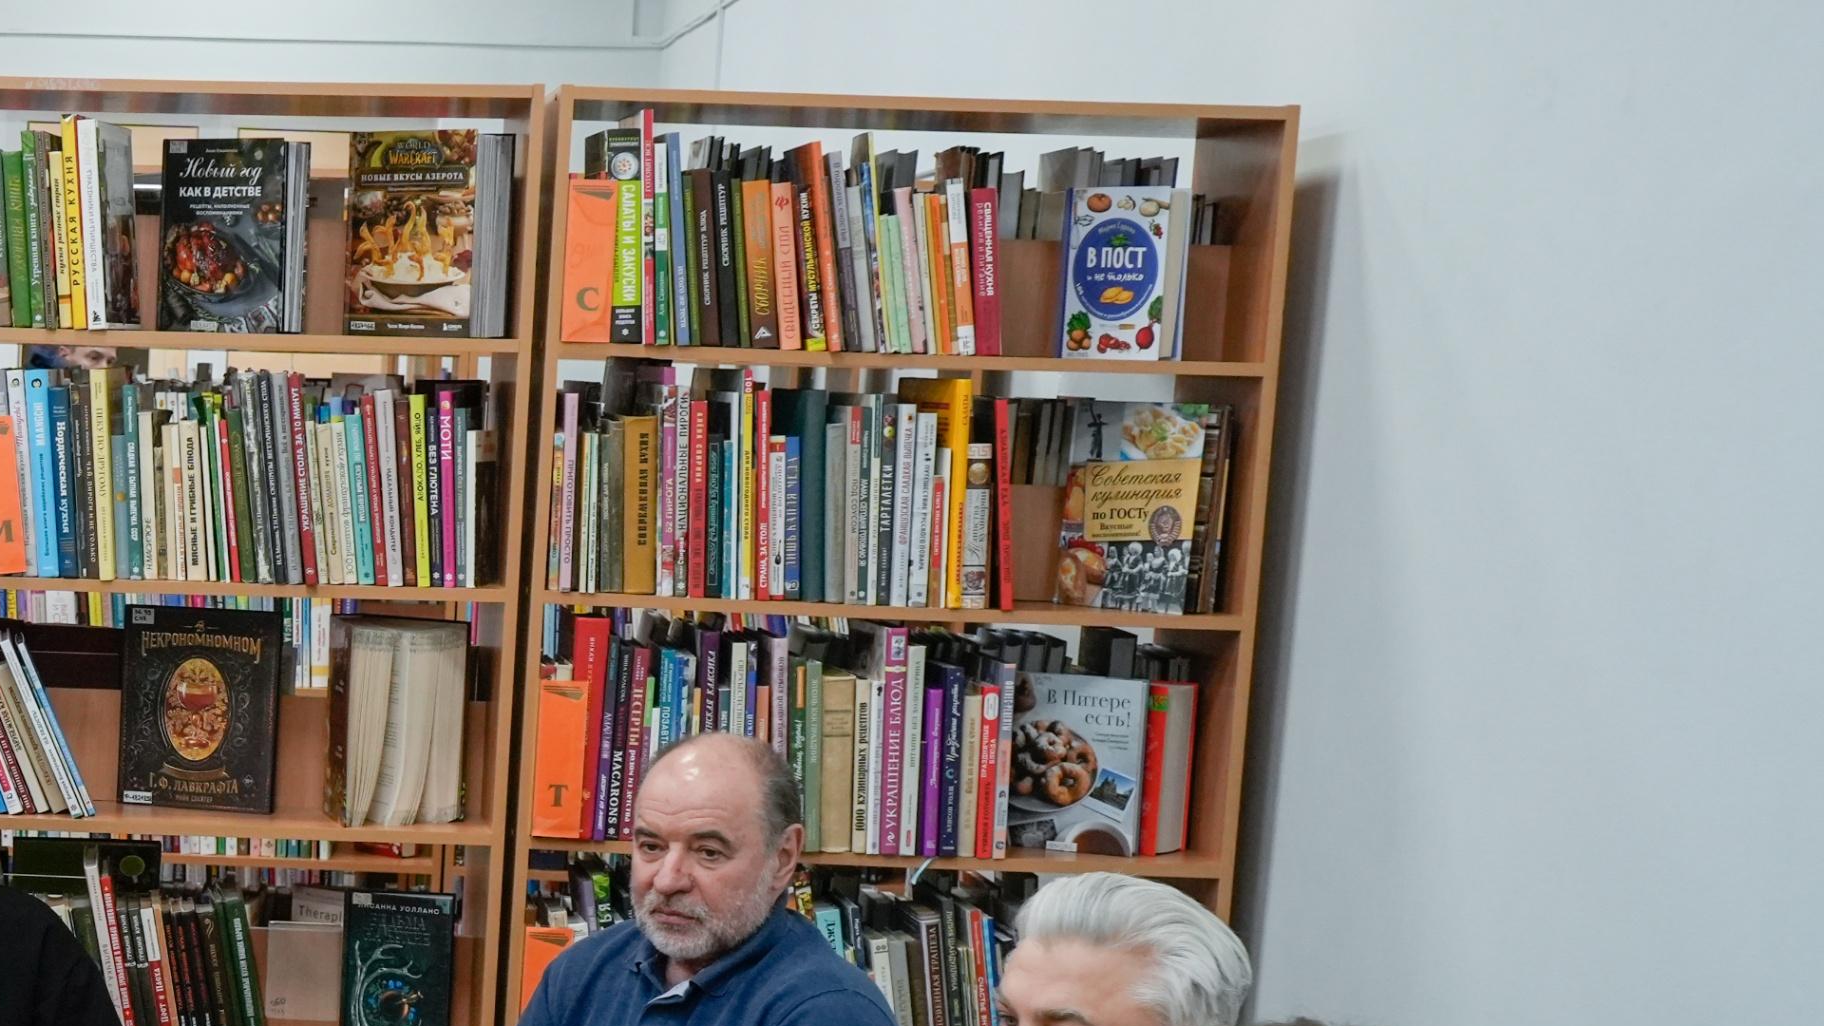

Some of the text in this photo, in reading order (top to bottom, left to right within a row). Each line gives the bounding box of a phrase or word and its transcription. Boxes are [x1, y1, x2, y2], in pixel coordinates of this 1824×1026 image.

[179, 186, 201, 198] КАК
[213, 186, 262, 198] ДЕТСТВЕ
[361, 171, 464, 182] НОВЫЕ ВКУСЫ АЗЕРОТА
[65, 156, 80, 285] РУССКАЯ КУХНЯ
[622, 184, 636, 232] САЛАТЫ
[718, 184, 730, 266] СБОРНИК РЕЦЕПТУР
[984, 202, 993, 262] СВЯЩЕННАЯ
[623, 248, 637, 301] ЗАКУСКИ
[799, 192, 821, 329] СЕКРЕТЫ МУСУЛЬМАНСКОЙ КУХНИ
[1086, 247, 1147, 268] В ПОСТ
[576, 286, 600, 312] С
[291, 387, 301, 419] МИНУТ
[186, 437, 195, 470] БЛЮДА
[440, 416, 452, 460] МОТИ
[56, 422, 72, 533] Нордическая кухня
[296, 448, 306, 476] СТОЛА
[428, 445, 439, 515] БЕЗ ГЛЮТЕНА
[678, 396, 688, 530] НАЦИОНАЛЬНЫЕ ПИРОГИ
[1091, 466, 1182, 487] Советская
[187, 473, 197, 515] ГРИБНЫЕ
[299, 478, 311, 531] УКРАШЕНИЕ
[880, 464, 893, 532] ТАРТАЛЕТКИ
[1091, 487, 1182, 508] кулинария
[1092, 511, 1106, 520] по
[190, 527, 199, 566] МЯСНЫЕ
[759, 557, 769, 587] СТРАНА,
[141, 630, 264, 665] НЕКРОНОМНОМНОМ
[1047, 689, 1131, 709] В Питере
[1084, 713, 1132, 728] есть!
[855, 702, 868, 831] 1000 кулинарных рецептов
[886, 678, 903, 828] УКРАШЕНИЕ БЛЮД
[548, 783, 569, 808] Т
[608, 750, 623, 824] MACARONS
[928, 927, 939, 971] ТРАПЕЗА
